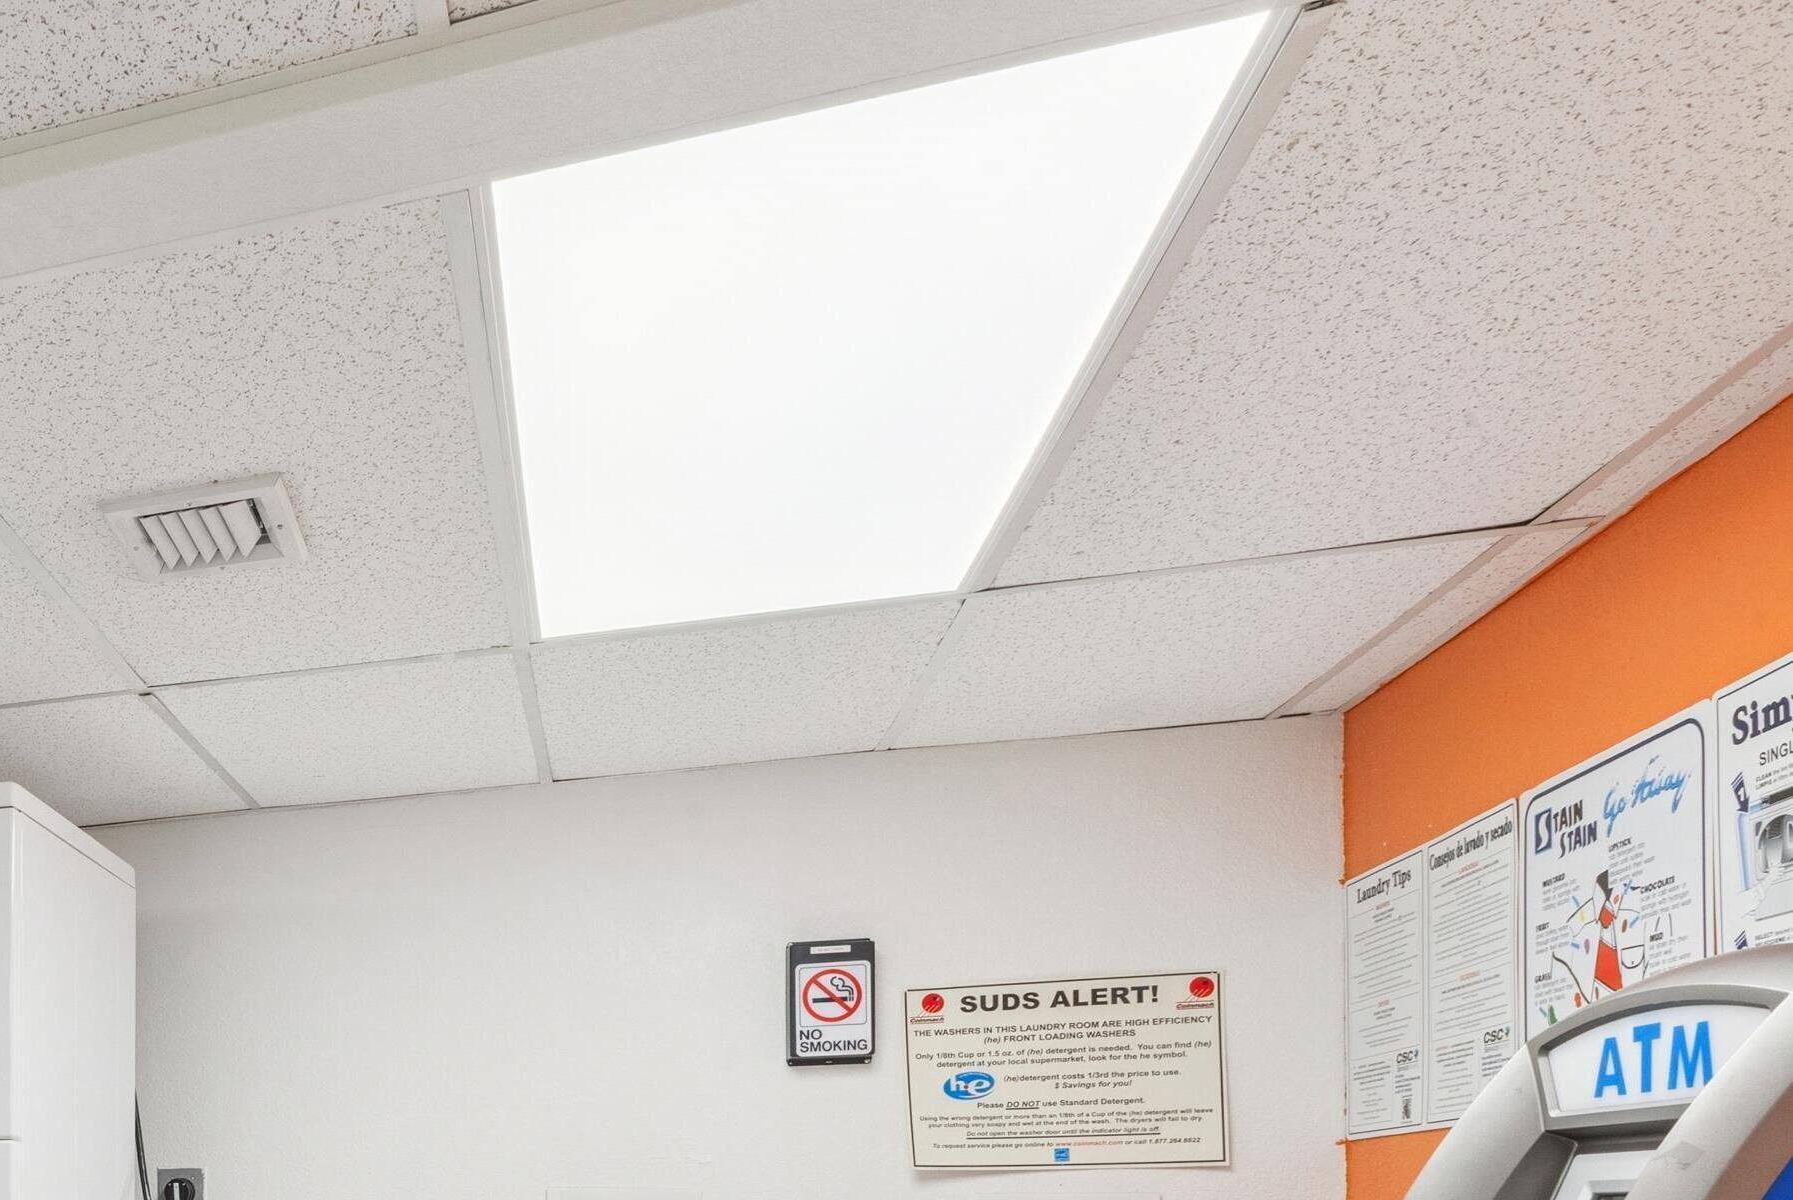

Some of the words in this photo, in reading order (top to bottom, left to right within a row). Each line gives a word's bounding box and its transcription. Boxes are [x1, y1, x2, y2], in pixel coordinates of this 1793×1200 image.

[1732, 693, 1793, 746] Sim
[1429, 848, 1456, 870] Consejos
[1457, 840, 1464, 858] de
[1464, 831, 1484, 855] lavado
[1490, 817, 1512, 842] secado
[1559, 821, 1597, 859] STAIN
[1357, 877, 1391, 904] Laundry
[1392, 869, 1412, 889] Tips
[1640, 876, 1675, 894] CHOCOLATE
[960, 992, 1040, 1013] SUDS
[1050, 985, 1159, 1008] ALERT!
[934, 1027, 981, 1036] WASHERS
[1020, 1023, 1066, 1032] LAUNDRY
[1069, 1021, 1099, 1029] ROOM
[1101, 1020, 1122, 1028] ARE
[1153, 1015, 1212, 1025] EFFICIENCY
[799, 1029, 822, 1041] NO
[984, 1036, 1001, 1045] (he)
[1003, 1034, 1036, 1042] FRONT
[1039, 1032, 1084, 1041] LOADING
[1086, 1029, 1136, 1038] WASHERS
[1483, 1029, 1504, 1043] CSC
[800, 1039, 868, 1053] SMOKING
[915, 1052, 934, 1061] Only
[937, 1051, 955, 1059] 1/8th
[958, 1051, 974, 1060] Cup
[1027, 1047, 1043, 1056] (he)
[1045, 1045, 1086, 1055] detergent
[1099, 1044, 1132, 1052] needed.
[1194, 1040, 1212, 1048] (he)
[937, 1060, 975, 1069] detergent
[987, 1059, 1006, 1067] your
[1008, 1057, 1028, 1065] local
[1030, 1055, 1085, 1066] supermarket,
[1124, 1052, 1137, 1060] the
[1153, 1051, 1188, 1060] symbol.
[1396, 1050, 1413, 1063] CSC
[1594, 1020, 1713, 1098] ATM
[1088, 1071, 1108, 1079] 1/3rd
[1111, 1070, 1125, 1078] the
[1127, 1070, 1149, 1079] price
[1062, 1080, 1096, 1090] Savings
[1098, 1080, 1111, 1088] for
[1113, 1079, 1133, 1088] you!
[977, 1101, 1004, 1109] Please
[1006, 1100, 1019, 1108] DO
[1021, 1100, 1041, 1108] NOT
[1059, 1098, 1098, 1106] Standard
[1101, 1096, 1145, 1105] Detergent.
